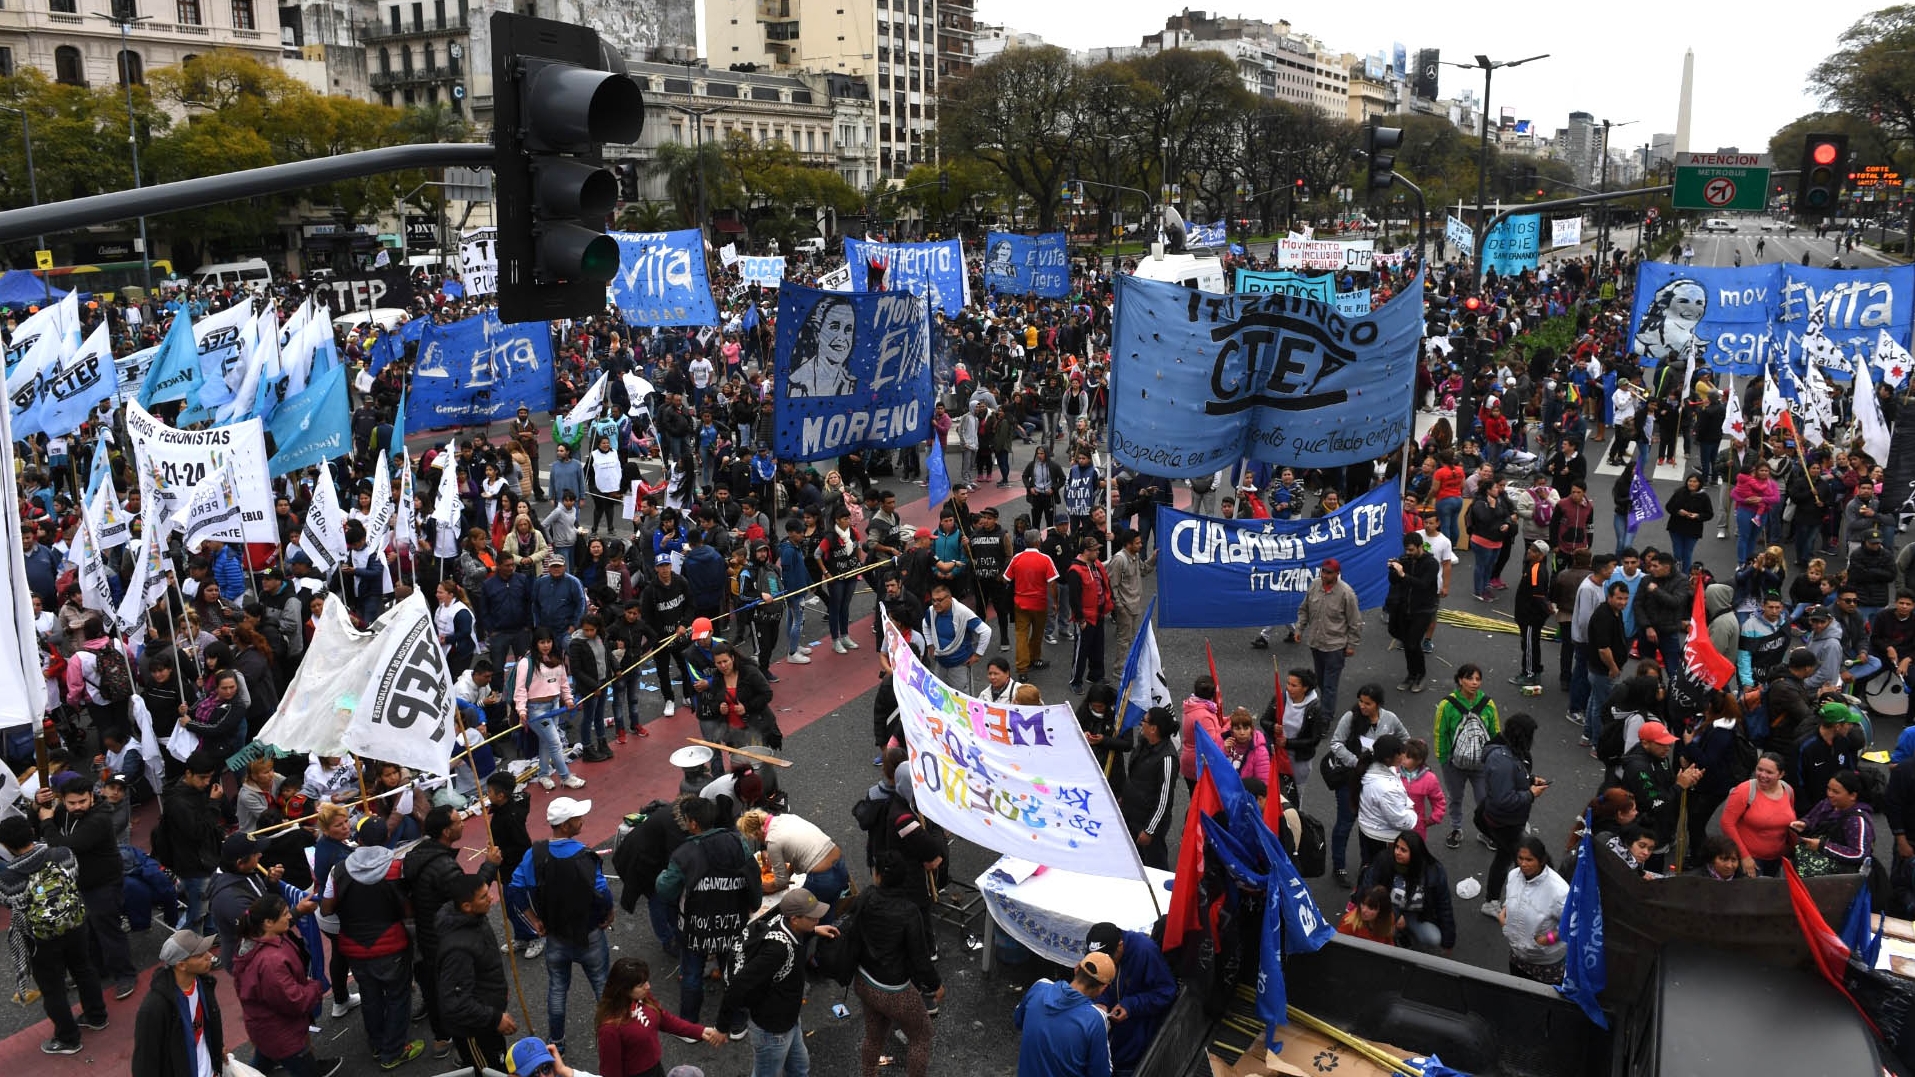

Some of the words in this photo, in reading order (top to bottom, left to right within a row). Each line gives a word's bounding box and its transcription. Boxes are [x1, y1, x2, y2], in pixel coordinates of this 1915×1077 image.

[1691, 154, 1758, 166] ATENCION
[1697, 168, 1747, 177] METROBUS
[609, 233, 668, 242] OVIMIENTO
[1281, 239, 1340, 250] MOVIMIENTO
[1346, 248, 1372, 267] CTEP
[1301, 250, 1343, 260] INCLUSION
[312, 279, 387, 312] CTEP
[1211, 330, 1347, 400] CTEP
[51, 356, 101, 399] CTEP
[802, 399, 919, 457] MORENO
[158, 430, 230, 446] PERONISTAS
[242, 510, 264, 523] EBLO
[1352, 502, 1388, 547] CTEP
[715, 913, 741, 930] EVITA
[687, 934, 699, 950] LA
